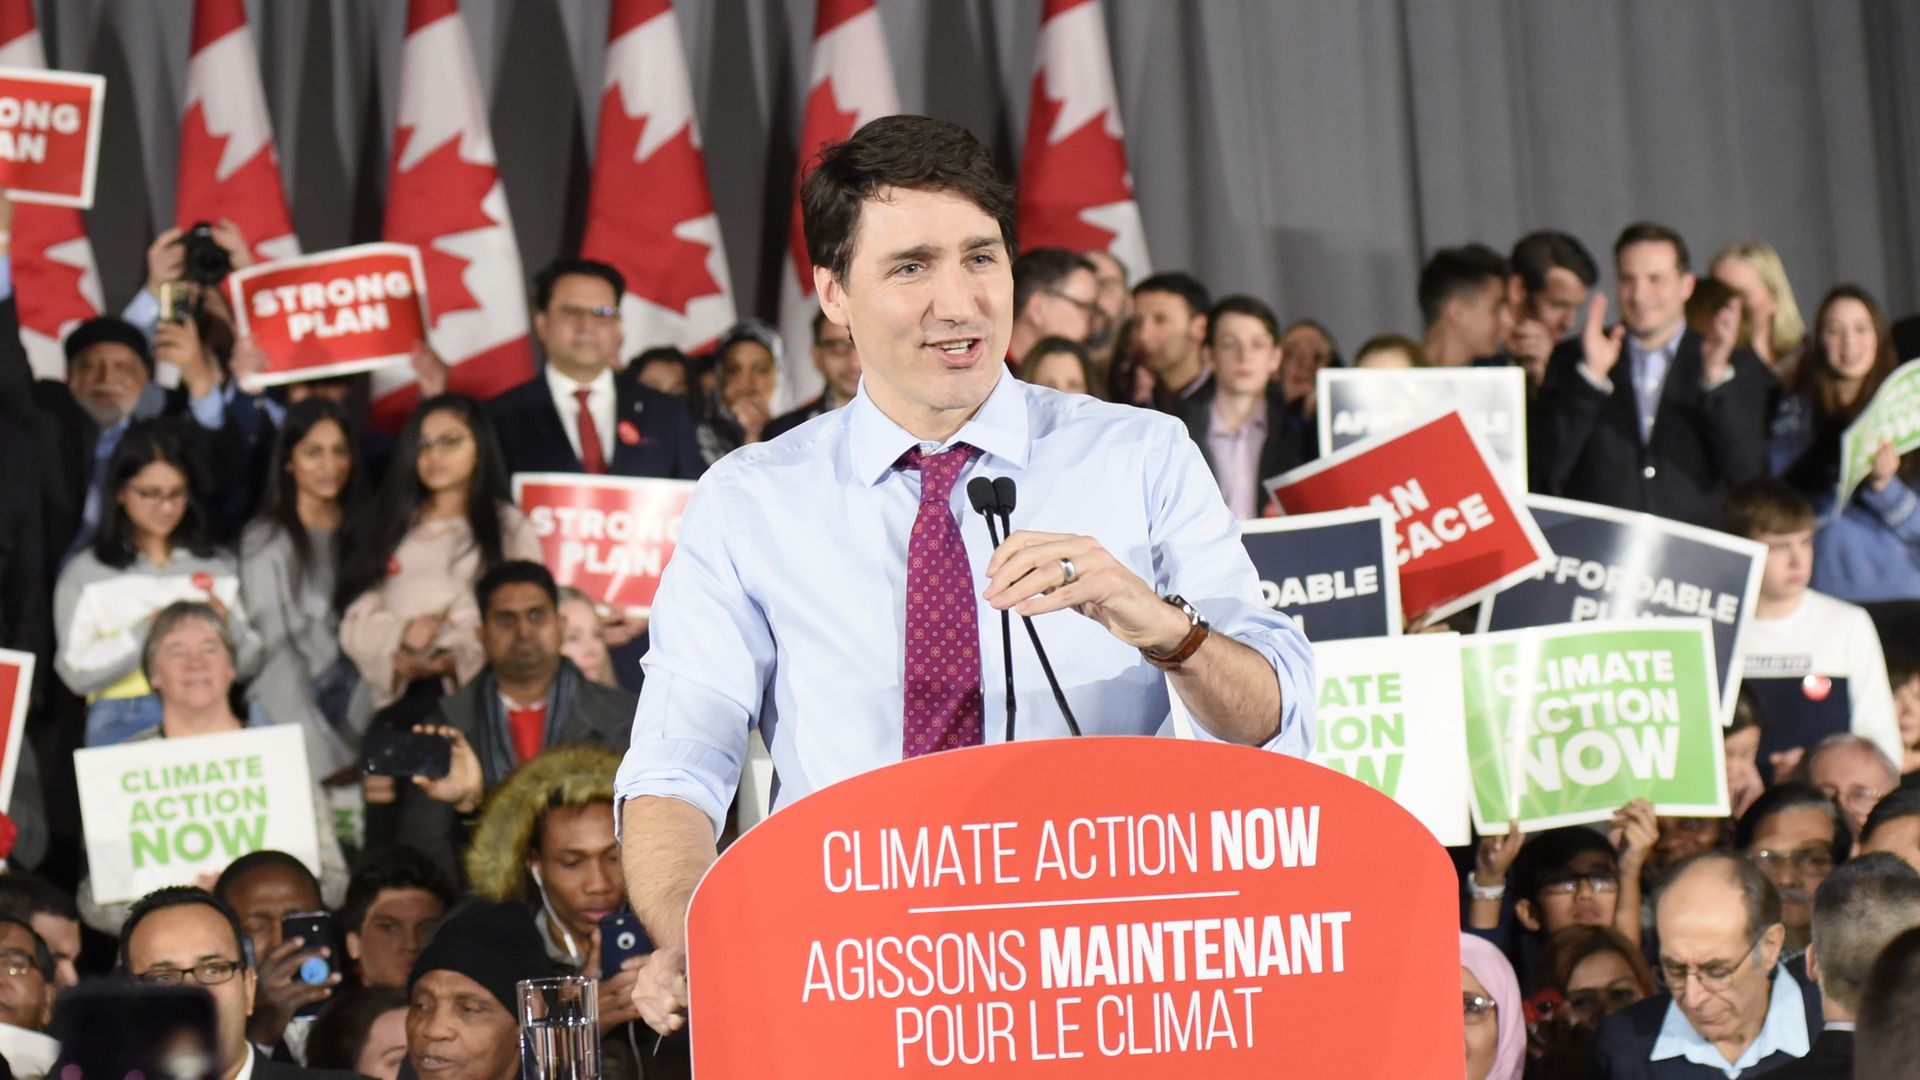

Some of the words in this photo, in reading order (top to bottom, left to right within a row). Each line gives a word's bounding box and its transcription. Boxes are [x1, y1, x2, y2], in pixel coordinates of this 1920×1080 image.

[252, 271, 412, 318] STRONG
[287, 303, 390, 342] PLAN
[560, 541, 662, 577] PLAN
[1318, 672, 1403, 708] ATE
[1494, 649, 1676, 698] CLIMATE
[1505, 688, 1680, 739] ACTION
[121, 755, 263, 794] CLIMATE
[1507, 725, 1680, 797] NOW
[129, 784, 268, 825] ACTION
[130, 814, 268, 869] NOW
[823, 822, 1020, 893] CLIMATE
[1034, 812, 1198, 882] ACTION
[1210, 805, 1320, 872] NOW
[802, 929, 1027, 1003] AGISSONS
[1040, 911, 1352, 989] MAINTENANT
[896, 1003, 1017, 1068] POUR
[1029, 997, 1084, 1061] LE
[1096, 987, 1262, 1057] CLIMAT
